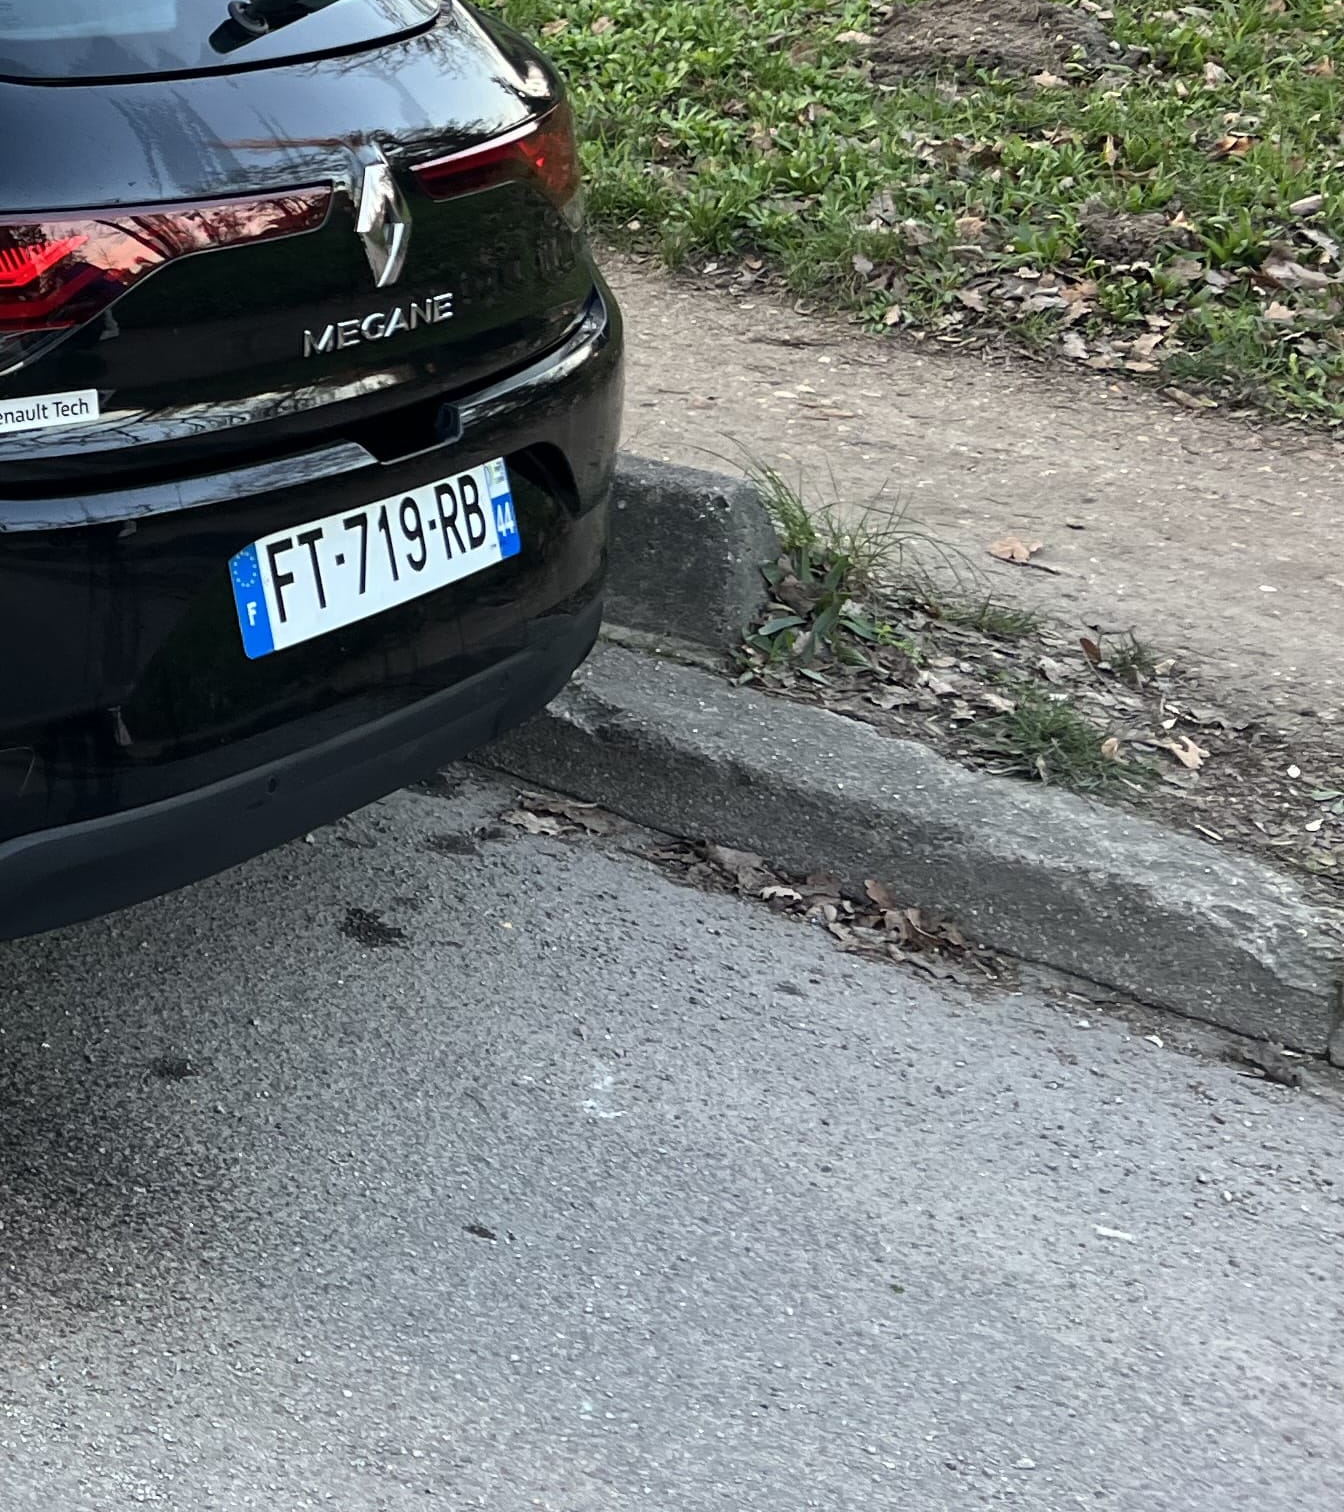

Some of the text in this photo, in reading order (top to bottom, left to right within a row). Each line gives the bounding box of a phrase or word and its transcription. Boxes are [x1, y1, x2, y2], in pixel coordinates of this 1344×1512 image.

[303, 292, 453, 358] MEGANE
[52, 398, 89, 418] Tech
[496, 501, 515, 537] 44
[266, 474, 486, 623] FT-719-RB
[246, 601, 257, 626] F
